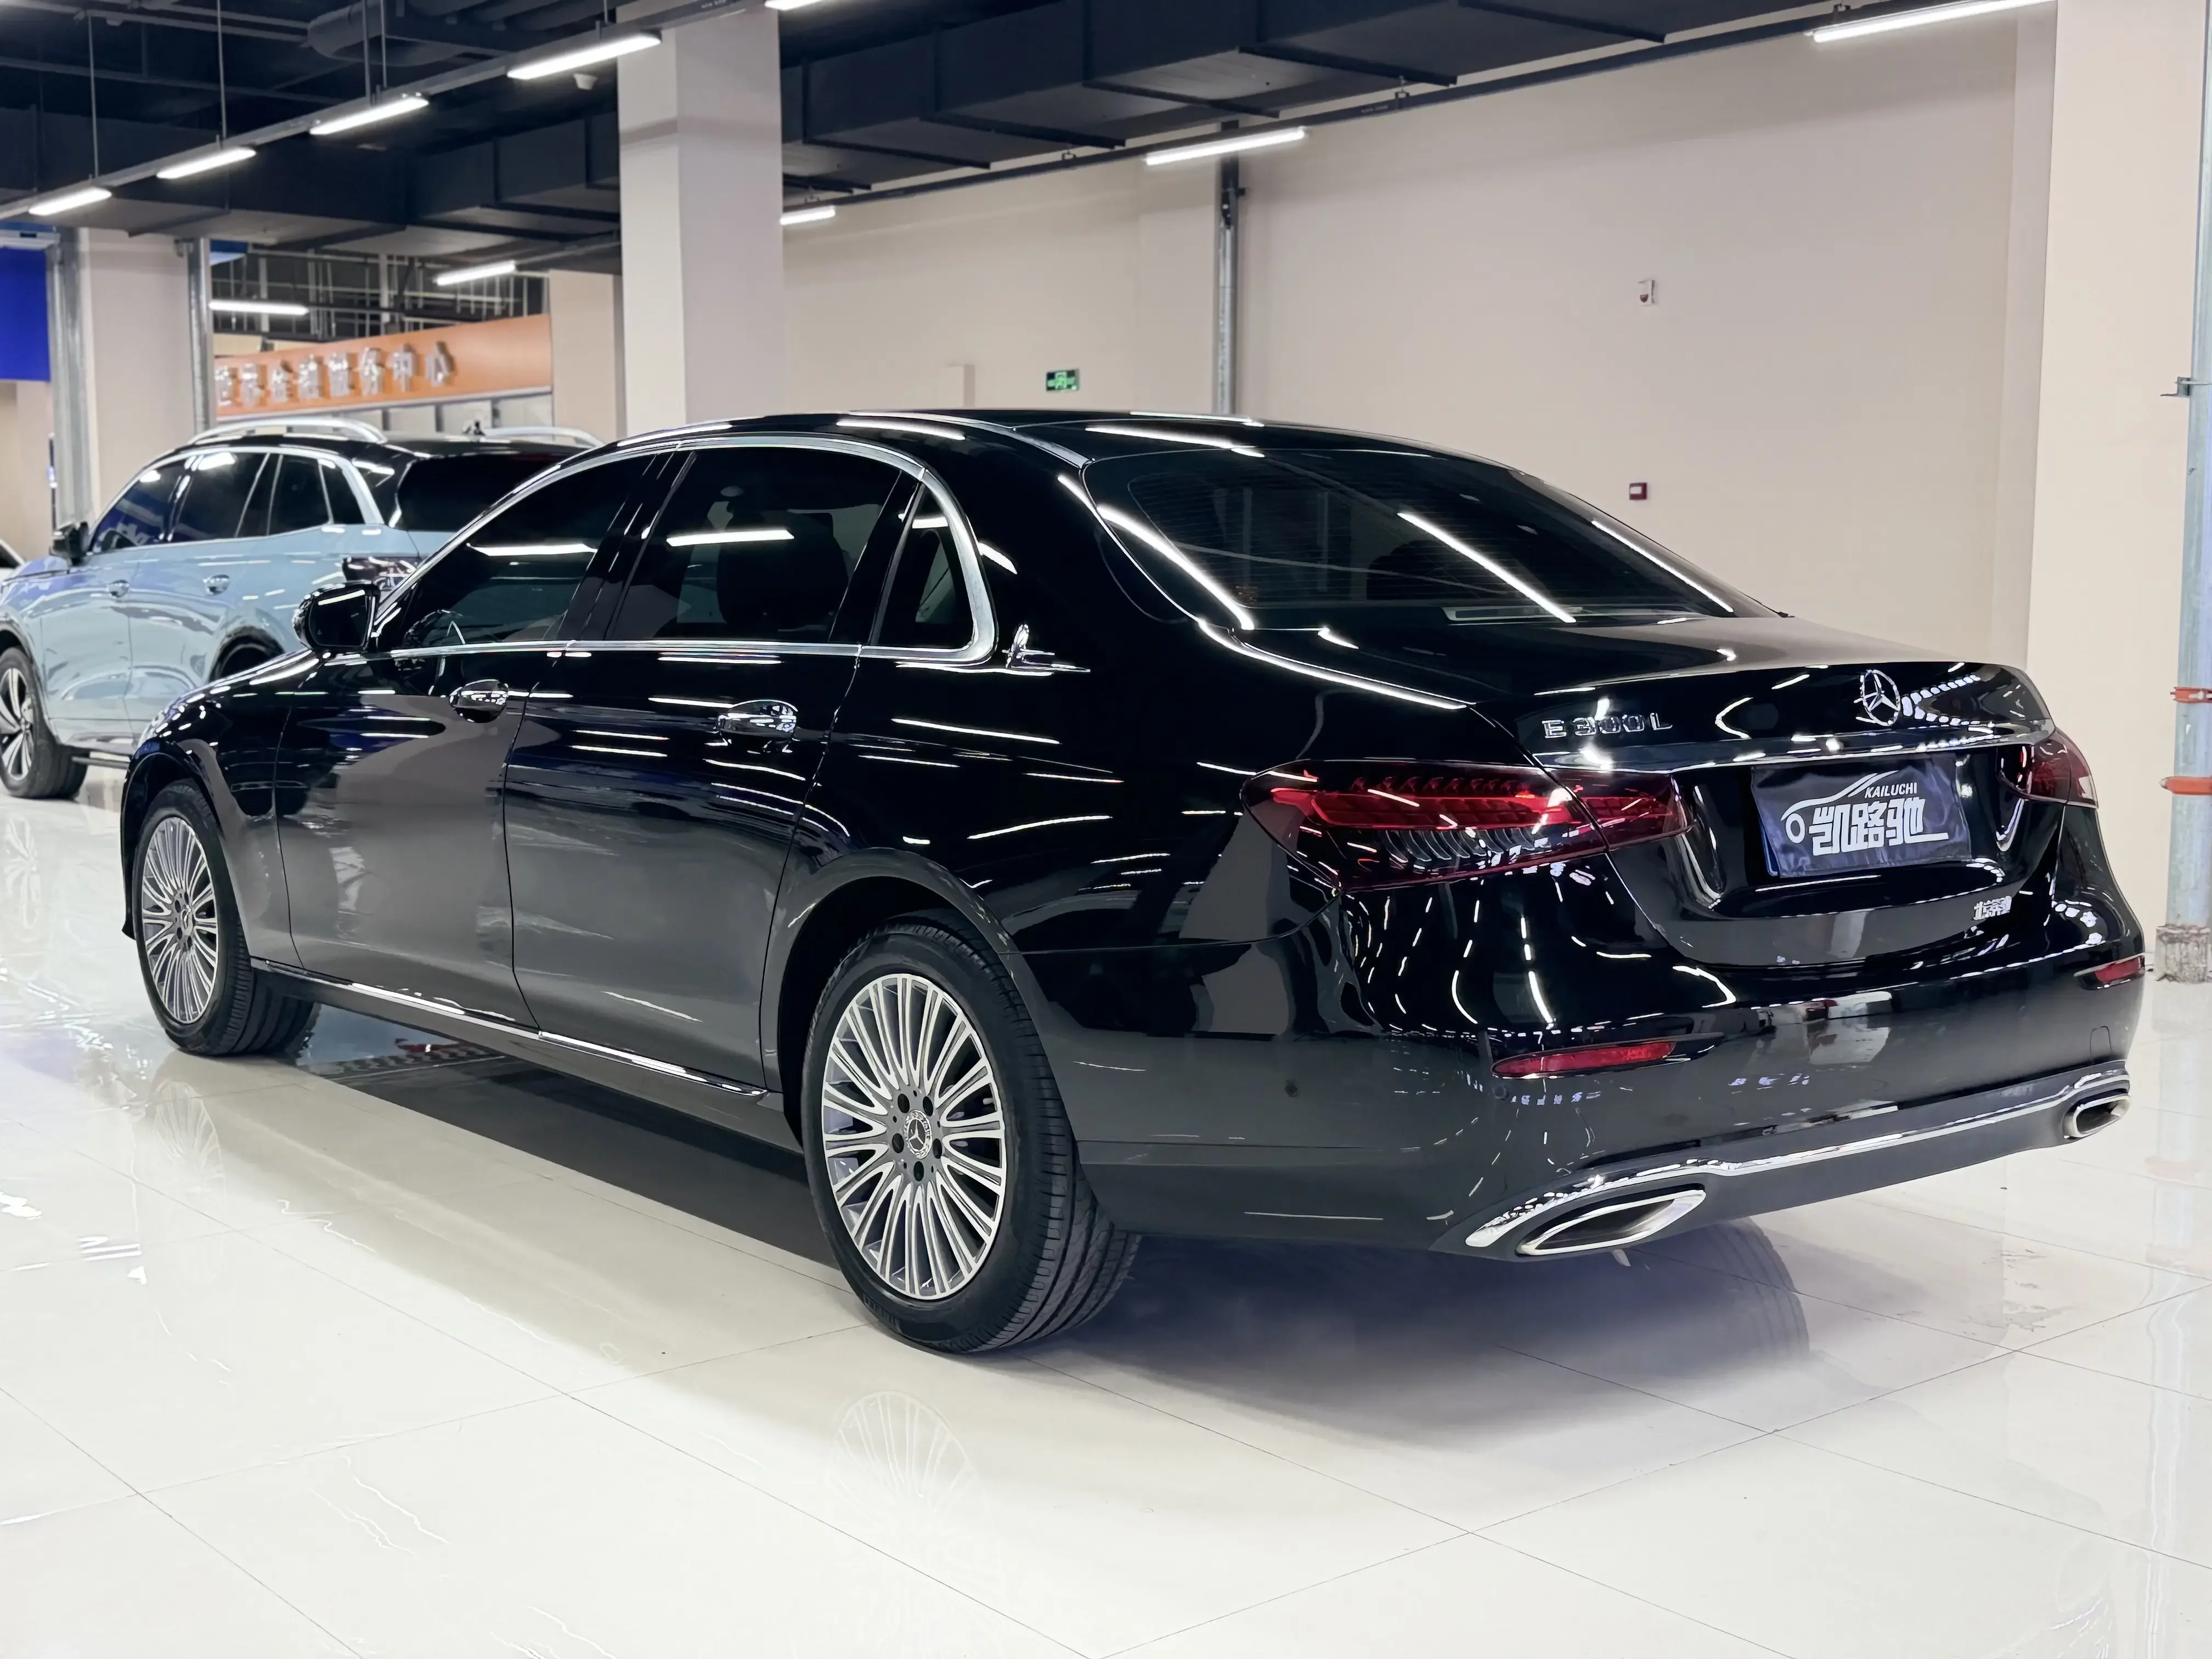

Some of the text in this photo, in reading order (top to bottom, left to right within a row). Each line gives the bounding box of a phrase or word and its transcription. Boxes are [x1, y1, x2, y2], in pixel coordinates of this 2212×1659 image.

[1864, 782, 1917, 799] KAILUCHI
[1809, 797, 1949, 856] 凯路驰
